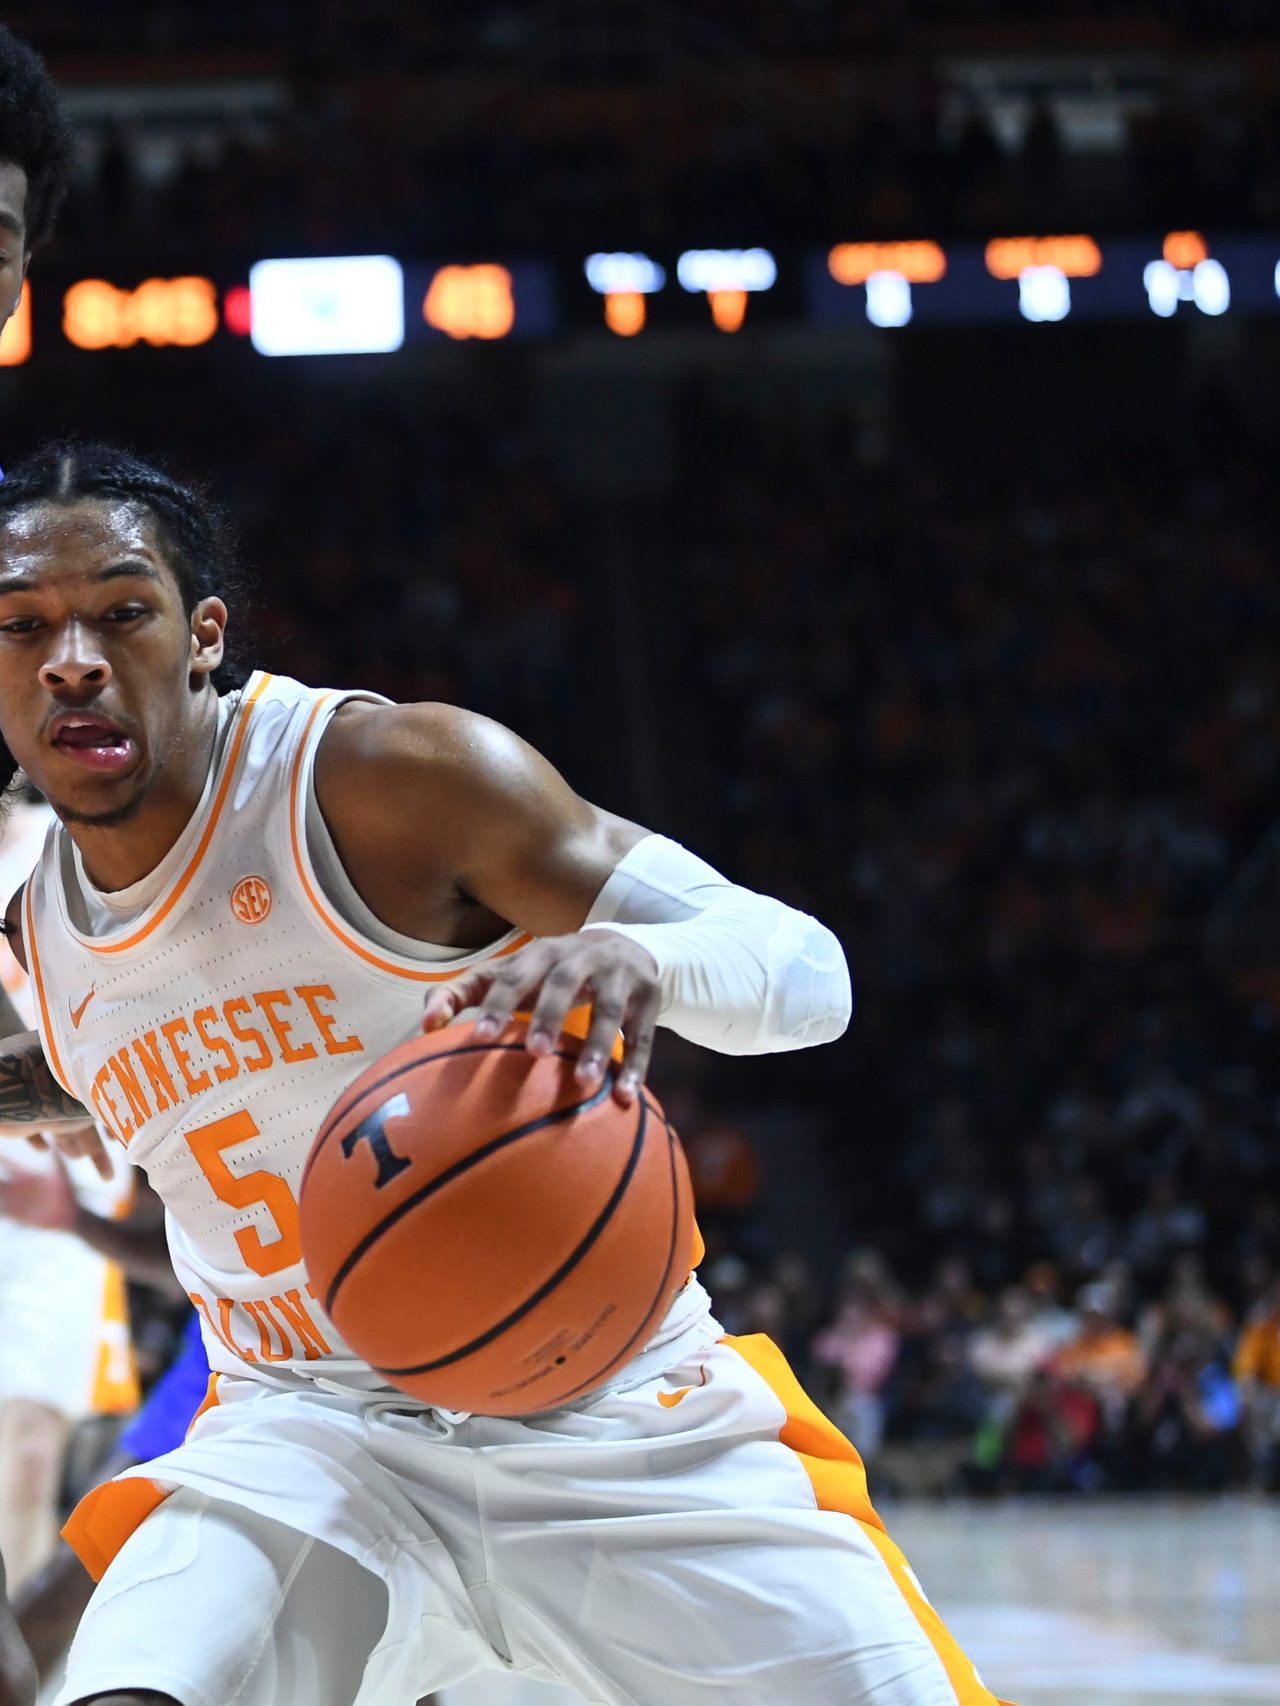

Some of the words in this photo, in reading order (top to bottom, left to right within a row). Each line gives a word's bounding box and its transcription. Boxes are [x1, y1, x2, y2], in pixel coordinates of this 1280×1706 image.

[233, 879, 269, 921] SEC
[340, 1091, 413, 1190] T
[184, 1108, 303, 1278] 5
[189, 1282, 332, 1363] LUN
